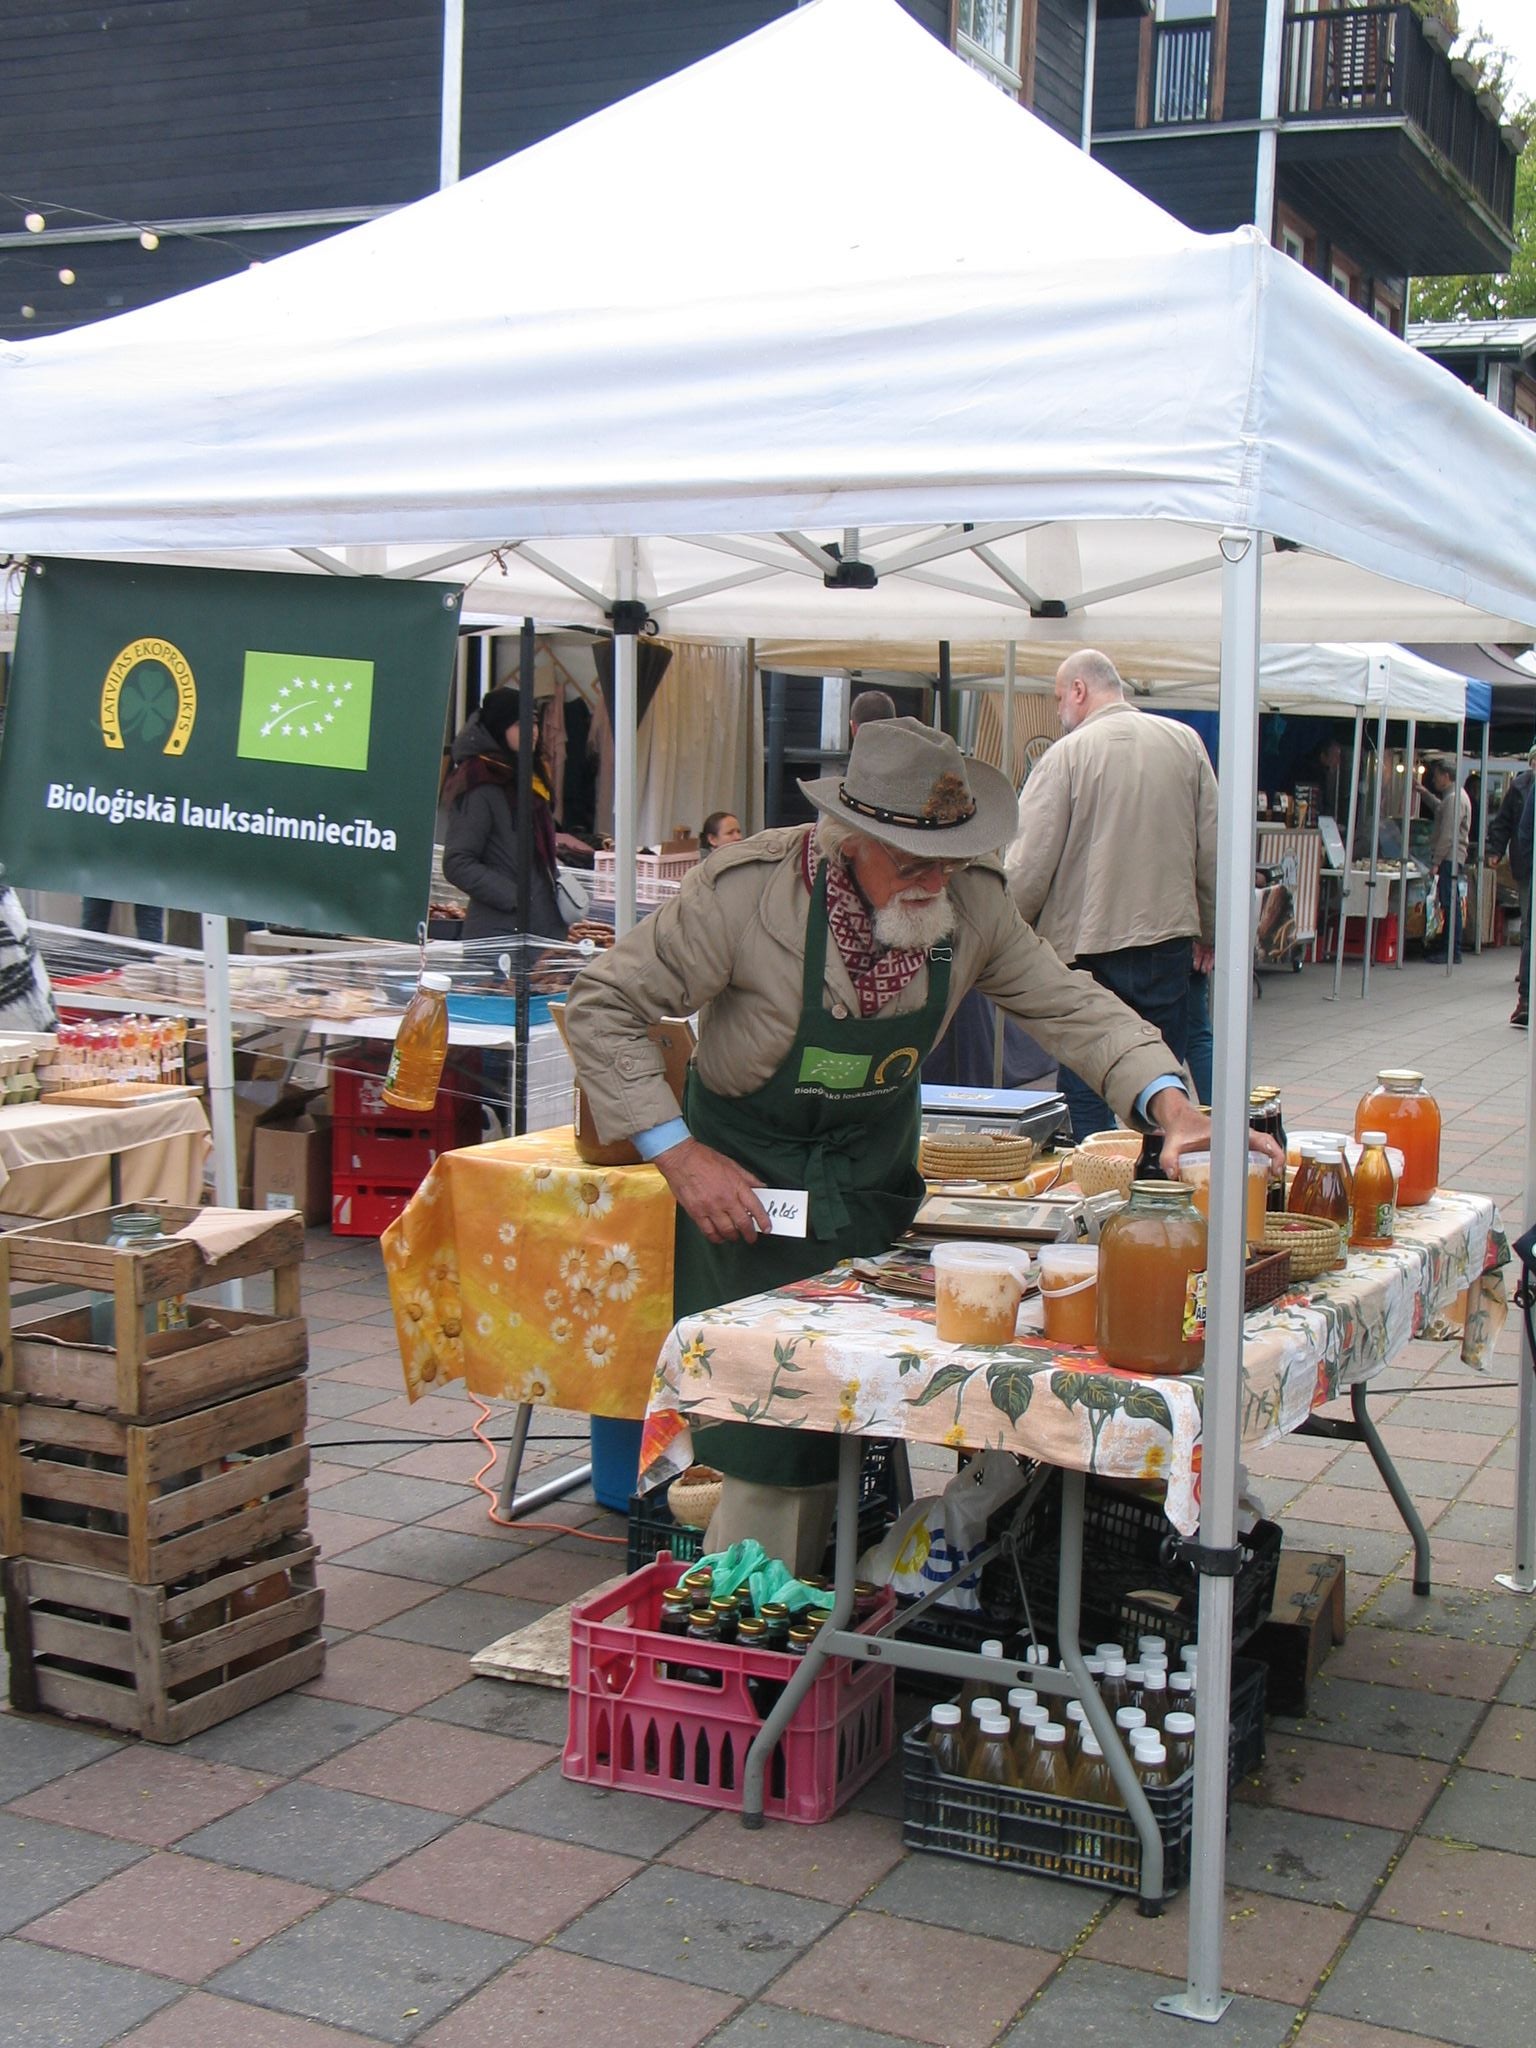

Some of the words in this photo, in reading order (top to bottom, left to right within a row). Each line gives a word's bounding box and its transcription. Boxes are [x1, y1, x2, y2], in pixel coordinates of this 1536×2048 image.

[104, 652, 133, 724] LATVIJAS
[134, 642, 194, 731] EKOPRODUKTS
[46, 783, 177, 824] Bioloģiskā
[181, 797, 398, 852] lauksaimniecība
